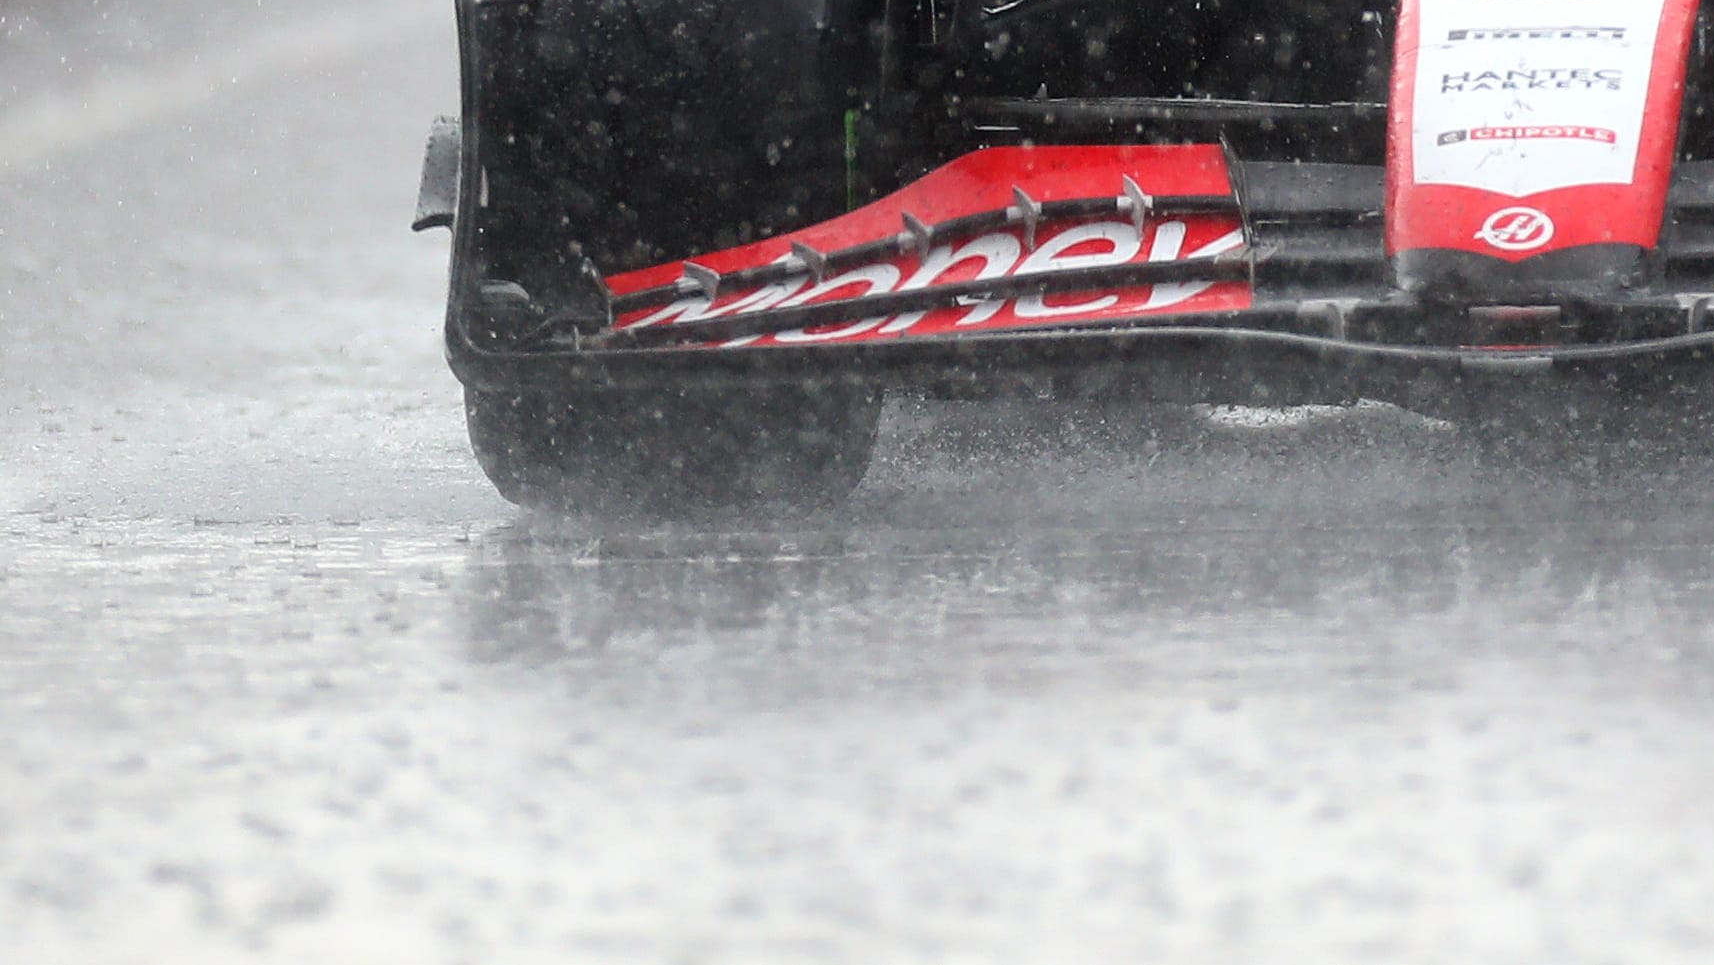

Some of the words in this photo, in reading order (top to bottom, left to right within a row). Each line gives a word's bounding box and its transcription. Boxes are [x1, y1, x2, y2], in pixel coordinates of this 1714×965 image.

[1448, 26, 1627, 41] PIRELLI
[1442, 68, 1622, 84] HANTEC
[1441, 79, 1621, 94] MARKETS
[1474, 125, 1612, 142] CHIPOTLE
[626, 219, 1245, 347] Money
